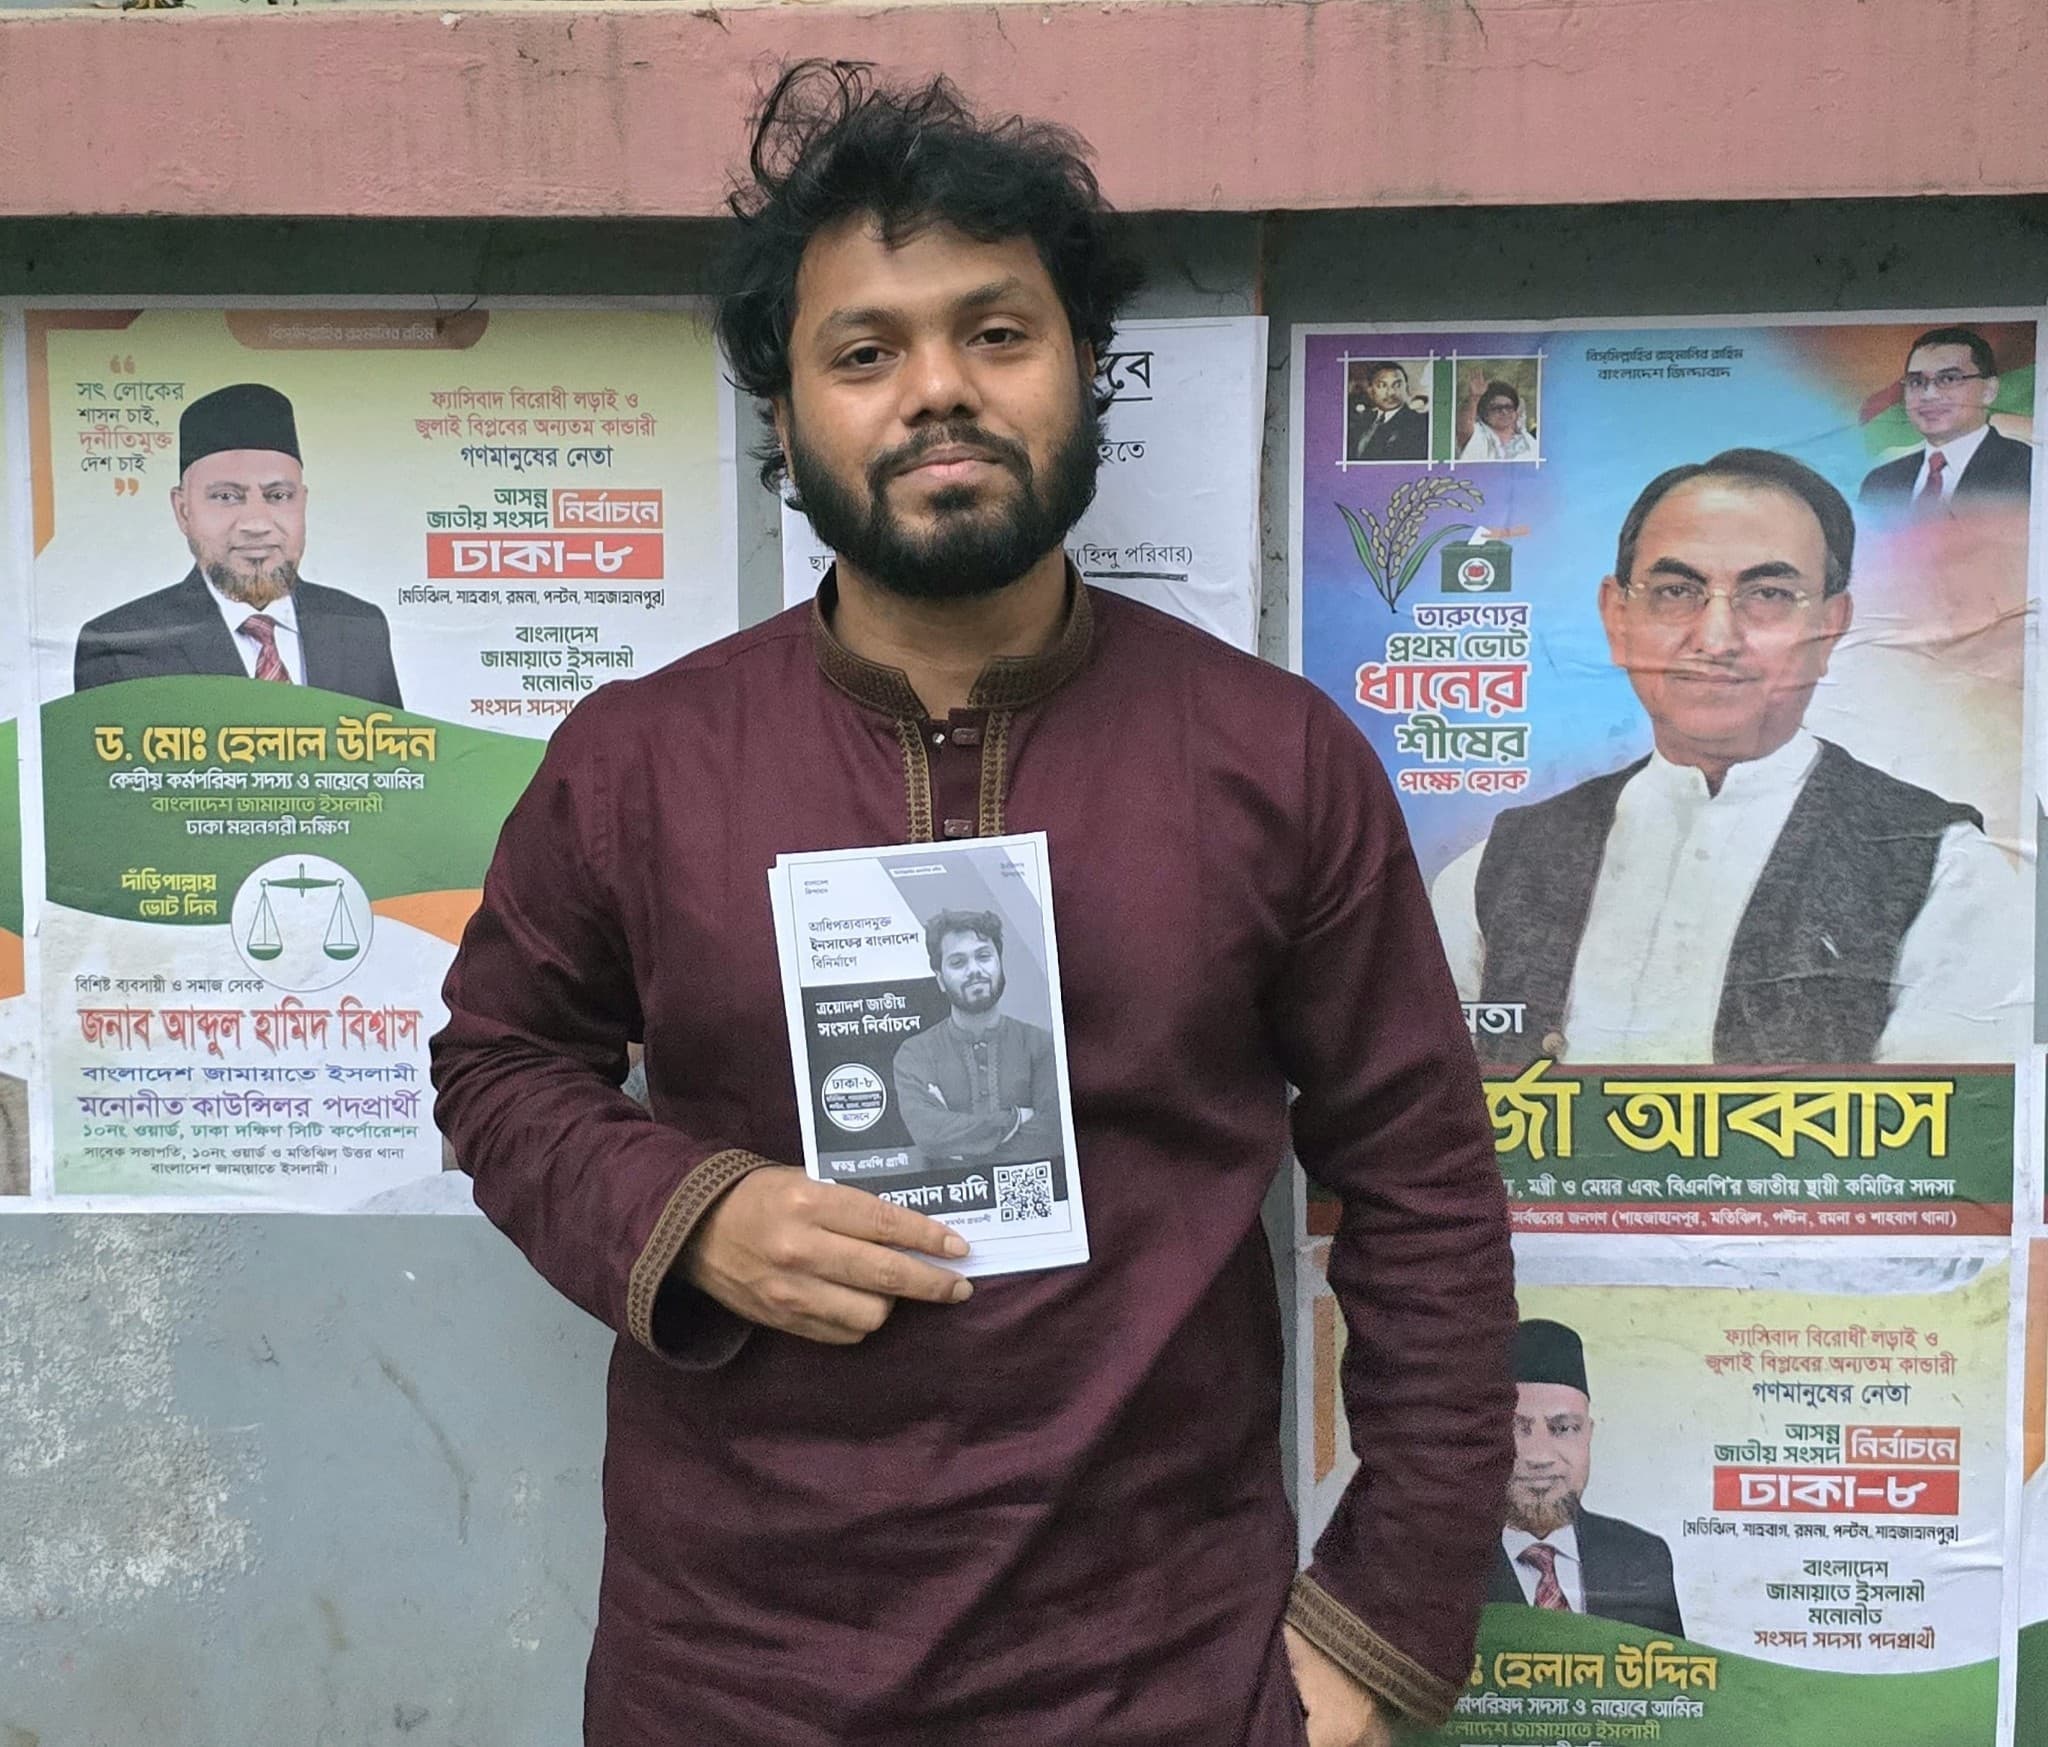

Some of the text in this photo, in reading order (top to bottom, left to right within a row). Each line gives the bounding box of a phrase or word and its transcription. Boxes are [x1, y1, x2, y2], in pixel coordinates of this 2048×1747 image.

[1597, 364, 1733, 381] বাংলাদেশ জিন্দাবাদ
[76, 382, 185, 401] সৎ লোকের
[430, 386, 639, 413] ফ্যাসিবাদ বিরোধী লড়াই ও
[77, 408, 121, 424] শাসন
[415, 415, 462, 440] জুলাই
[468, 414, 528, 438] বিপ্লবের
[534, 418, 595, 437] অন্যতম
[81, 453, 147, 474] দেশ চাই
[460, 446, 614, 473] গণমানুষের নেতা
[494, 487, 549, 510] আসন্ন
[557, 492, 659, 525] নির্বাচনে
[426, 505, 549, 531] জাতীয় সংসদ
[1076, 543, 1120, 568] (হিন্দু
[1125, 542, 1193, 566] পরিবার)
[1416, 605, 1529, 628] তারুণ্যের
[516, 625, 599, 644] বাংলাদেশ
[1388, 629, 1529, 662] প্রথম ভোট
[481, 645, 634, 669] জামায়াতে ইসলামী
[522, 670, 594, 692] মনোনীত
[1358, 664, 1528, 714] ধানের
[470, 699, 522, 716] সংসদ
[94, 712, 437, 765] ড. মোঃ হেলাল উদ্দিন
[1397, 714, 1528, 762] শীষের
[251, 772, 293, 790] সদস্য
[296, 773, 309, 789] ও
[373, 768, 425, 790] আমির
[1400, 769, 1528, 792] পক্ষে হোক
[151, 791, 383, 814] বাংলাদেশ জামায়াতে ইসলামী
[186, 814, 350, 835] ঢাকা মহানগরী দক্ষিণ
[139, 894, 217, 917] ভোট দিন
[865, 932, 919, 947] বাংলাদেশ
[75, 974, 111, 992] বিশিষ্ট
[172, 980, 184, 992] ও
[186, 979, 223, 992] সমাজ
[227, 979, 265, 992] সেবক
[866, 992, 907, 1014] জাতীয়
[77, 995, 422, 1060] জনাব আব্দুল হামিদ বিশ্বাস
[817, 1014, 921, 1038] সংসদ নির্বাচনে
[81, 1061, 418, 1084] বাংলাদেশ জামায়াতে ইসলামী
[77, 1087, 420, 1120] মনোনীত কাউন্সিলর পদপ্রার্থী
[82, 1123, 128, 1138] ১০নং
[191, 1125, 228, 1138] ঢাকা
[236, 1122, 282, 1139] দক্ষিণ
[288, 1121, 323, 1138] সিটি
[330, 1123, 419, 1139] কর্পোরেশন
[1603, 1080, 1955, 1160] আব্বাস
[84, 1148, 125, 1159] সাবেক
[271, 1149, 281, 1159] ও
[287, 1146, 337, 1159] মতিঝিল
[342, 1146, 372, 1160] উত্তর
[377, 1148, 404, 1159] থানা
[151, 1163, 210, 1175] বাংলাদেশ
[946, 1174, 989, 1203] হাদি
[1562, 1180, 1576, 1195] ও
[1628, 1178, 1662, 1197] এবং
[1747, 1173, 1800, 1197] জাতীয়
[1844, 1173, 1905, 1196] কমিটির
[1910, 1179, 1956, 1197] সদস্য
[1818, 1211, 1850, 1226] রমনা
[1855, 1212, 1866, 1225] ও
[1871, 1211, 1917, 1226] শাহবাগ
[1921, 1210, 1957, 1228] থানা)
[1724, 1325, 1938, 1351] ফ্যাসিবাদ বিরোধী লড়াই ও
[1706, 1352, 1753, 1378] জুলাই
[1761, 1352, 1823, 1375] বিপ্লবের
[1829, 1356, 1891, 1375] অন্যতম
[1752, 1382, 1912, 1409] গণমানুষের নেতা
[1785, 1423, 1840, 1447] আসন্ন
[1851, 1427, 1956, 1461] নির্বাচনে
[1714, 1438, 1840, 1465] জাতীয় সংসদ
[1803, 1559, 1888, 1578] বাংলাদেশ
[1766, 1579, 1925, 1603] জামায়াতে ইসলামী
[1808, 1602, 1882, 1626] মনোনীত
[1754, 1624, 1935, 1650] সংসদ সদস্য পদপ্রার্থী
[1494, 1653, 1604, 1689] হেলাল
[1615, 1640, 1718, 1690] উদ্দিন
[1527, 1698, 1569, 1716] সদস্য
[1572, 1700, 1587, 1715] ও
[1651, 1694, 1705, 1718] আমির
[1595, 1719, 1661, 1740] ইসলামী
